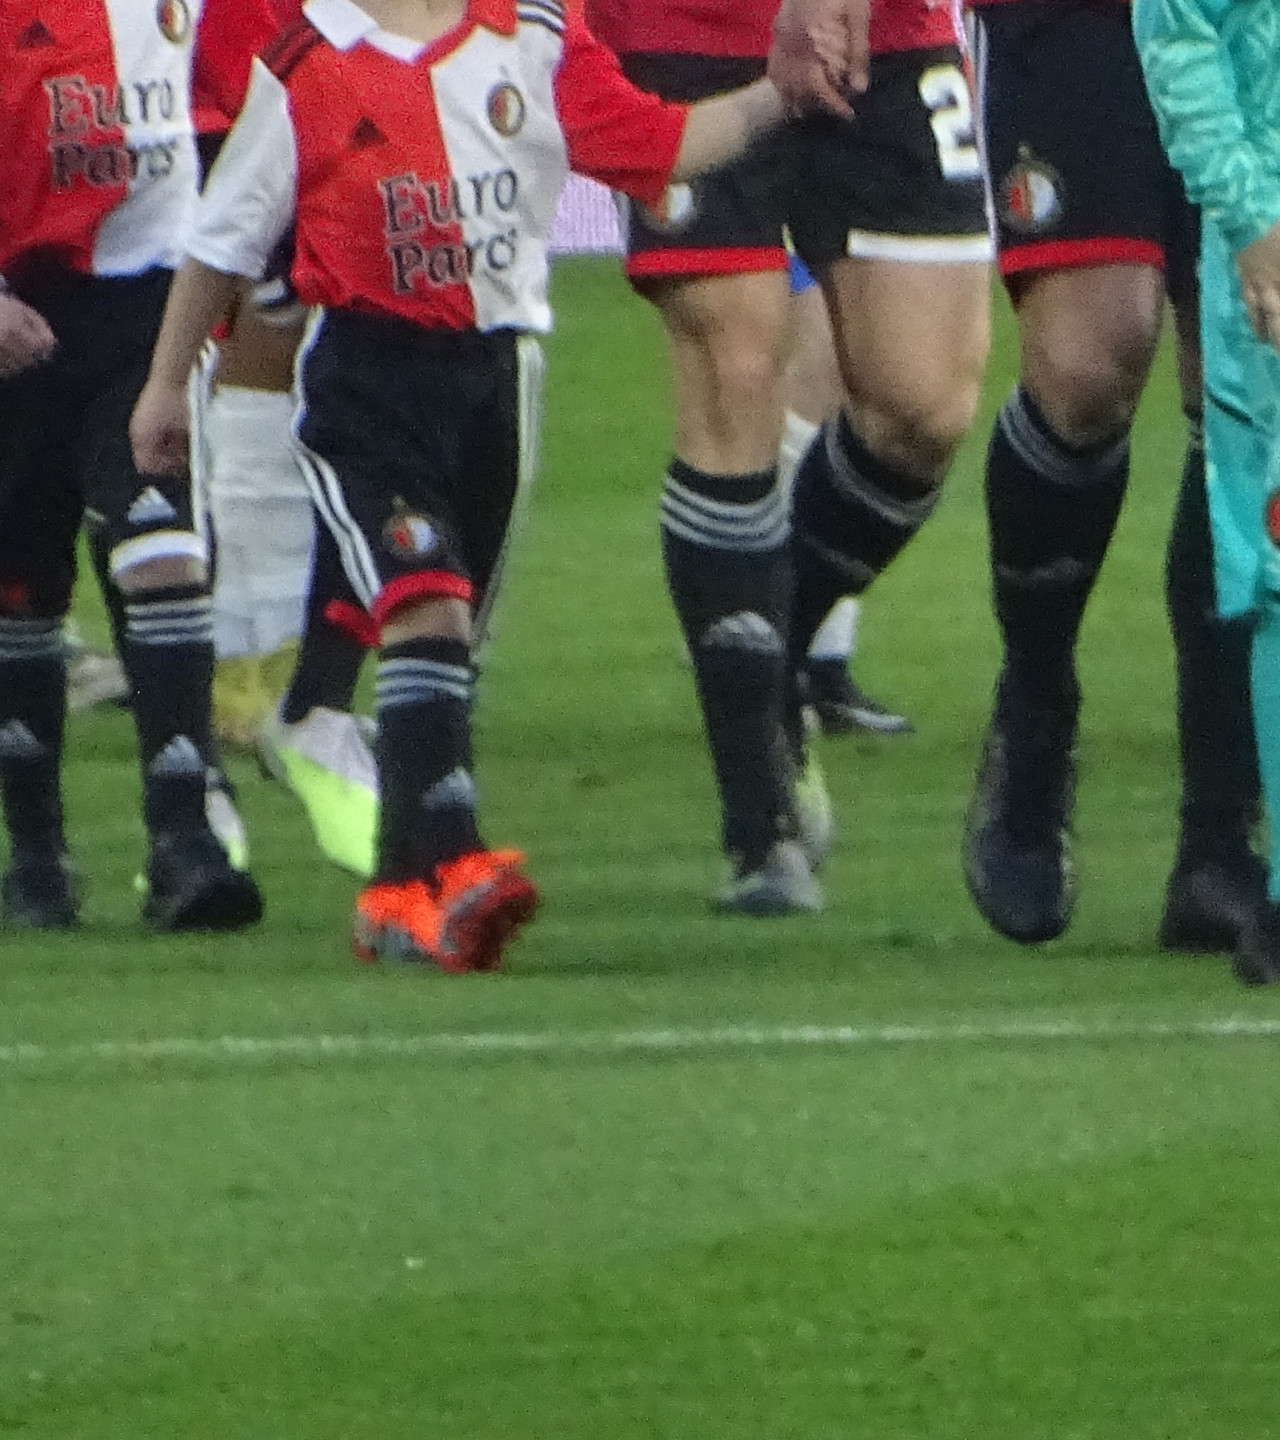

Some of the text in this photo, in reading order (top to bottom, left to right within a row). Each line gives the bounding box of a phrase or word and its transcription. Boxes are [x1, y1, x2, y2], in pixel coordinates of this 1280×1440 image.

[44, 74, 175, 137] Euro
[917, 62, 982, 182] 2
[377, 165, 519, 237] Euro
